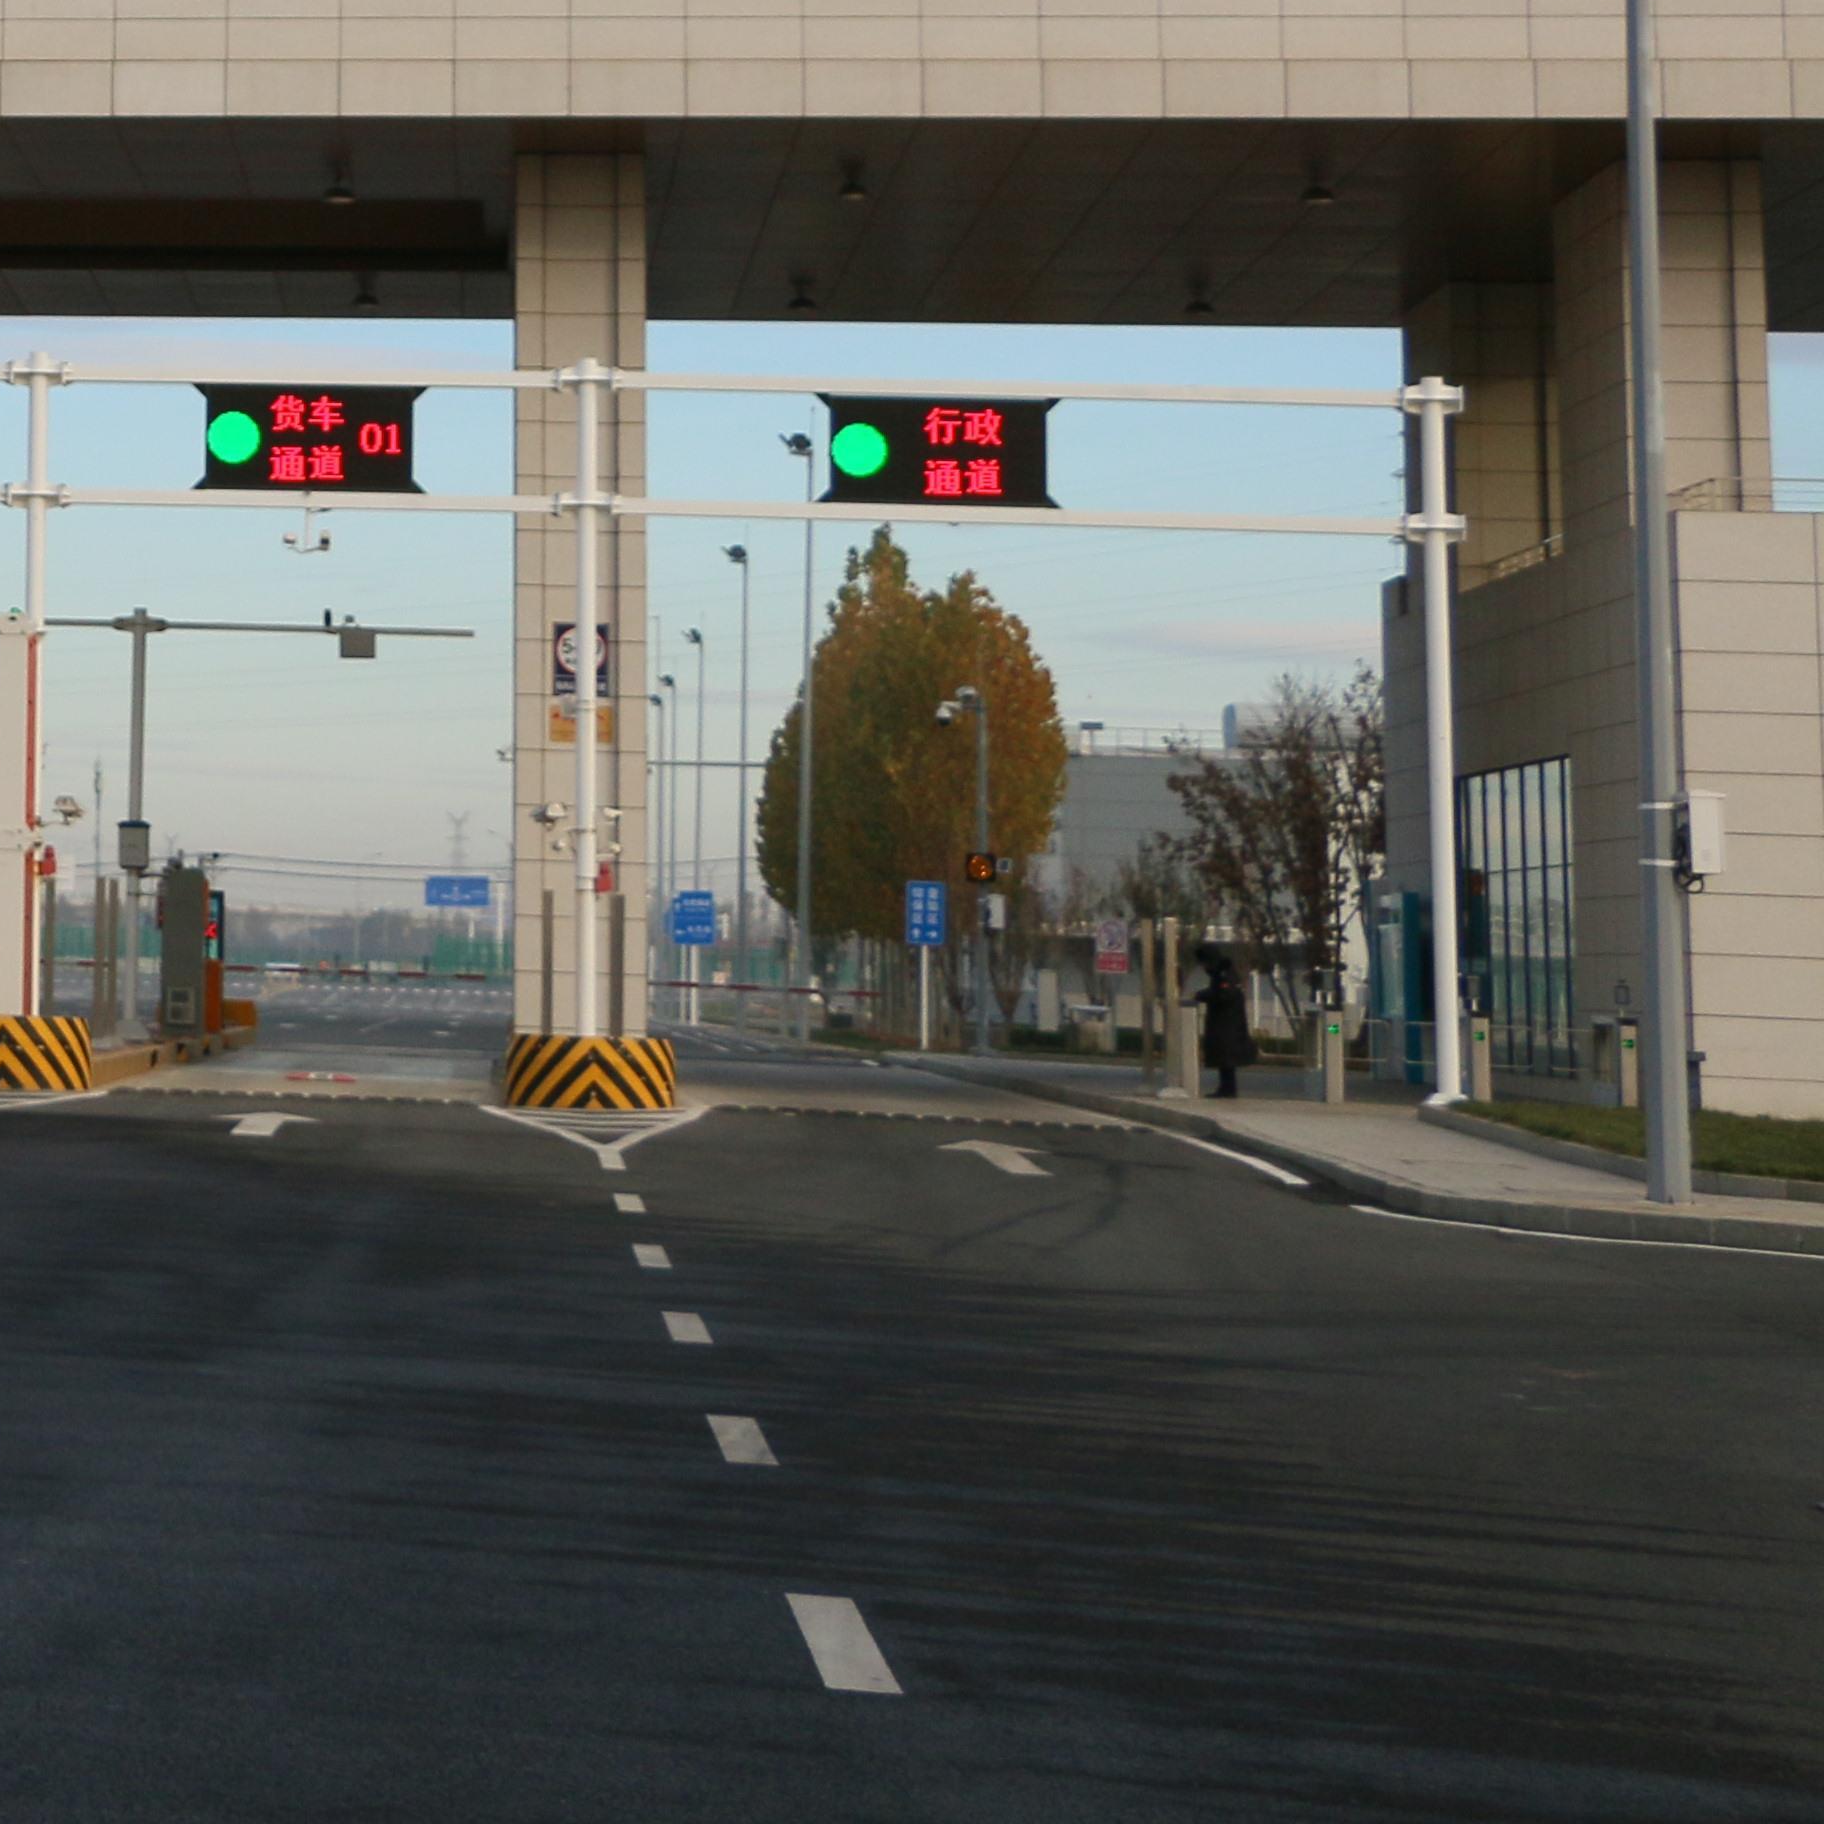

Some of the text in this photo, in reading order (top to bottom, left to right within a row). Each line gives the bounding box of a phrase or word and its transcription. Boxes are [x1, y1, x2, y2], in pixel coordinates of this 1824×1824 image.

[270, 394, 345, 432] 货车
[923, 407, 1002, 445] 行政
[359, 422, 402, 454] 01
[269, 444, 345, 481] 通道
[923, 459, 1002, 495] 通道
